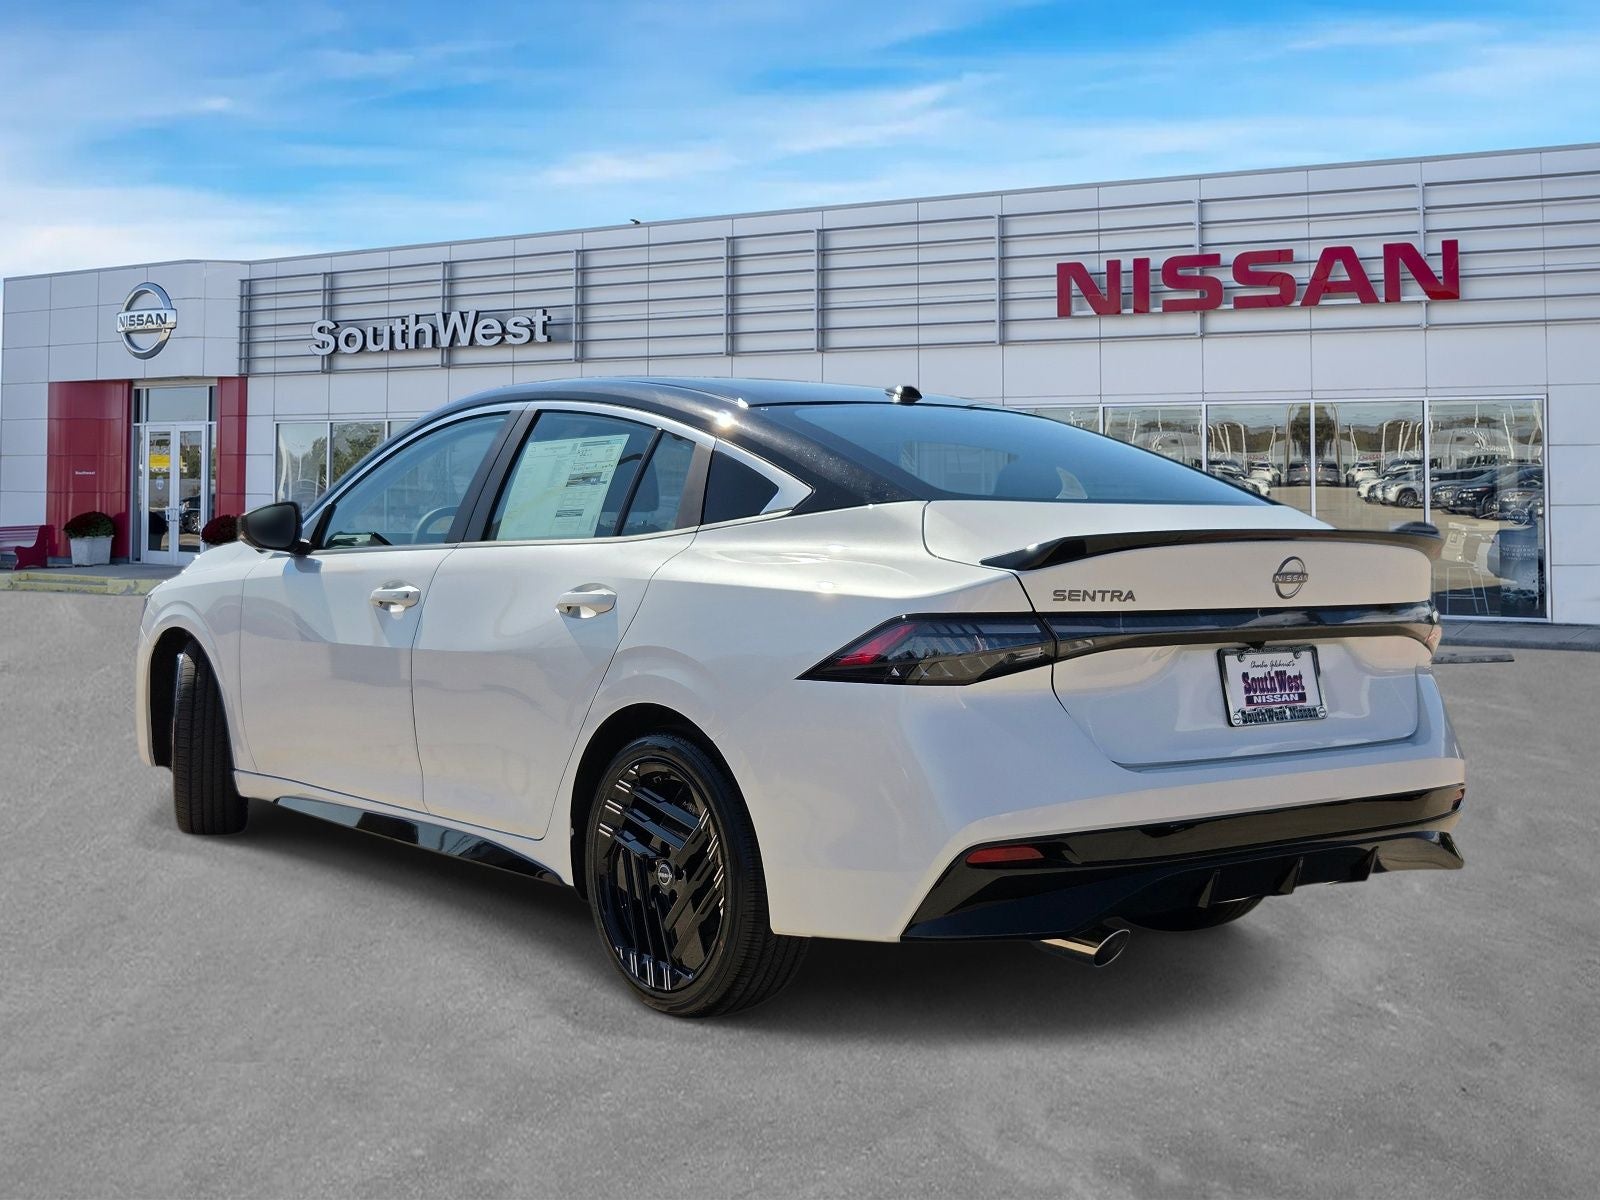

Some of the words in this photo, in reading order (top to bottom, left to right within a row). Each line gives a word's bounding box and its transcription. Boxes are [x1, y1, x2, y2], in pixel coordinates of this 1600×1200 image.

[1057, 239, 1461, 318] NISSAN
[119, 312, 168, 328] NISSAN
[309, 308, 552, 356] SouthWest
[1275, 573, 1308, 583] NISSAN
[1052, 588, 1137, 602] SENTRA
[1253, 693, 1299, 704] NISSAN
[1289, 705, 1319, 721] Nissan
